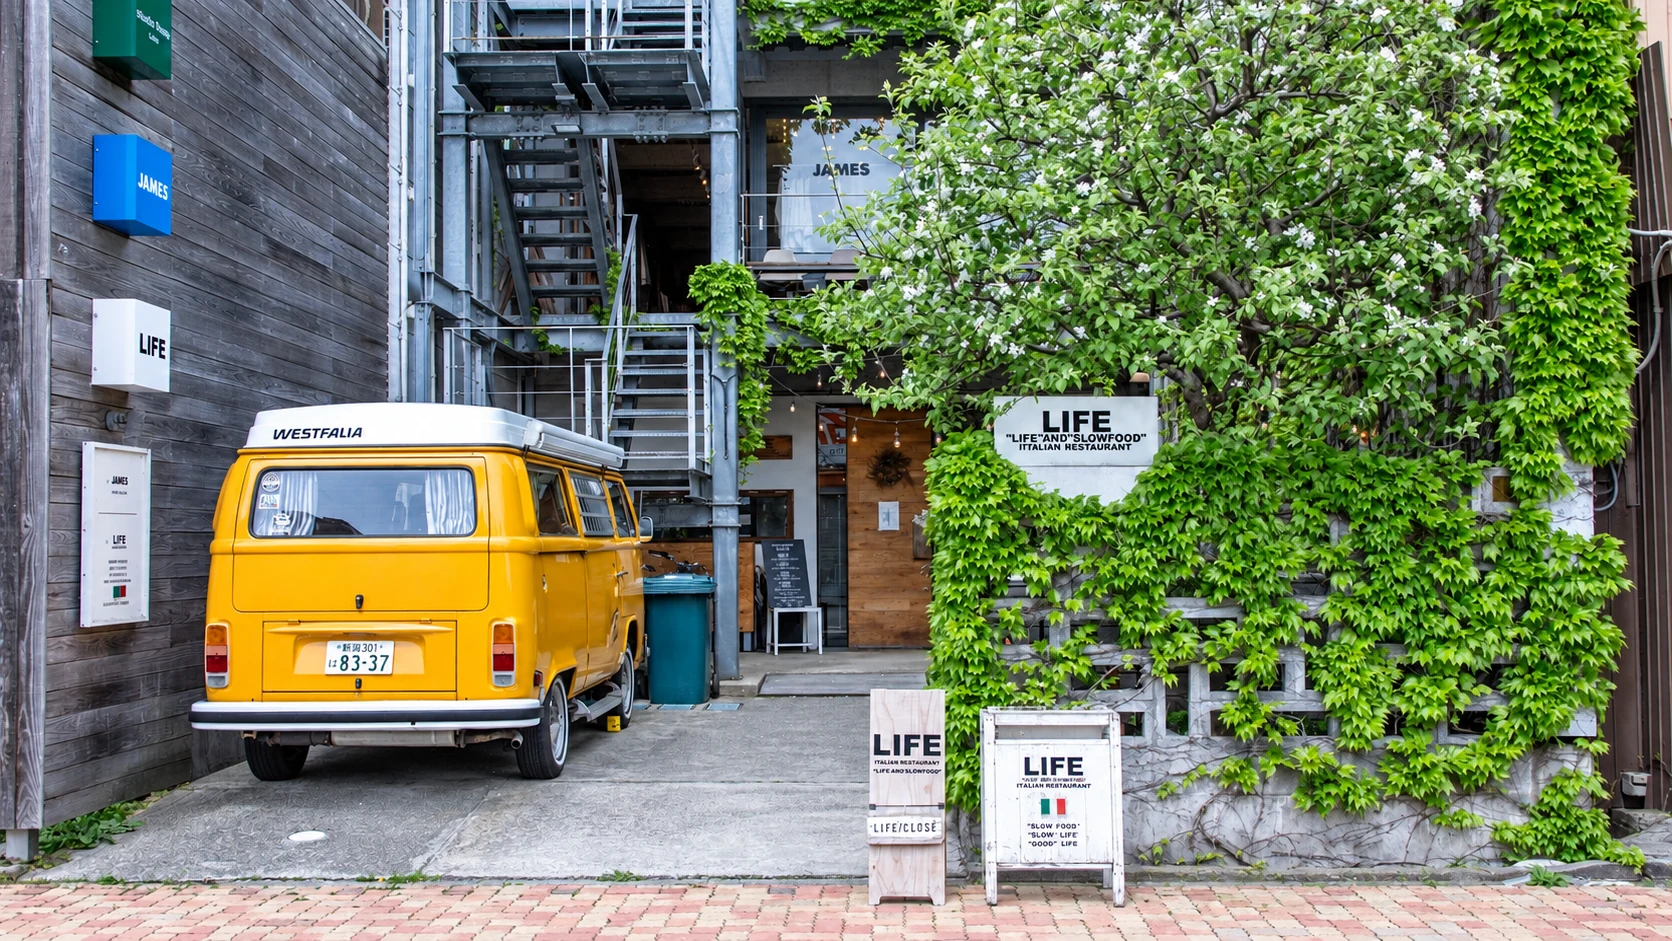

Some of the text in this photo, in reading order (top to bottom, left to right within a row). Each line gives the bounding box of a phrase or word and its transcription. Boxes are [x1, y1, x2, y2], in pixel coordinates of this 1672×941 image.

[812, 163, 870, 176] JAMES
[137, 172, 168, 200] JAMES
[139, 333, 166, 359] LIFE
[1042, 410, 1112, 432] LIFE
[273, 427, 363, 440] WESTFALIA
[112, 535, 126, 545] LIFE
[339, 654, 390, 672] 83-37
[873, 734, 942, 756] LIFE
[1024, 756, 1084, 776] LIFE
